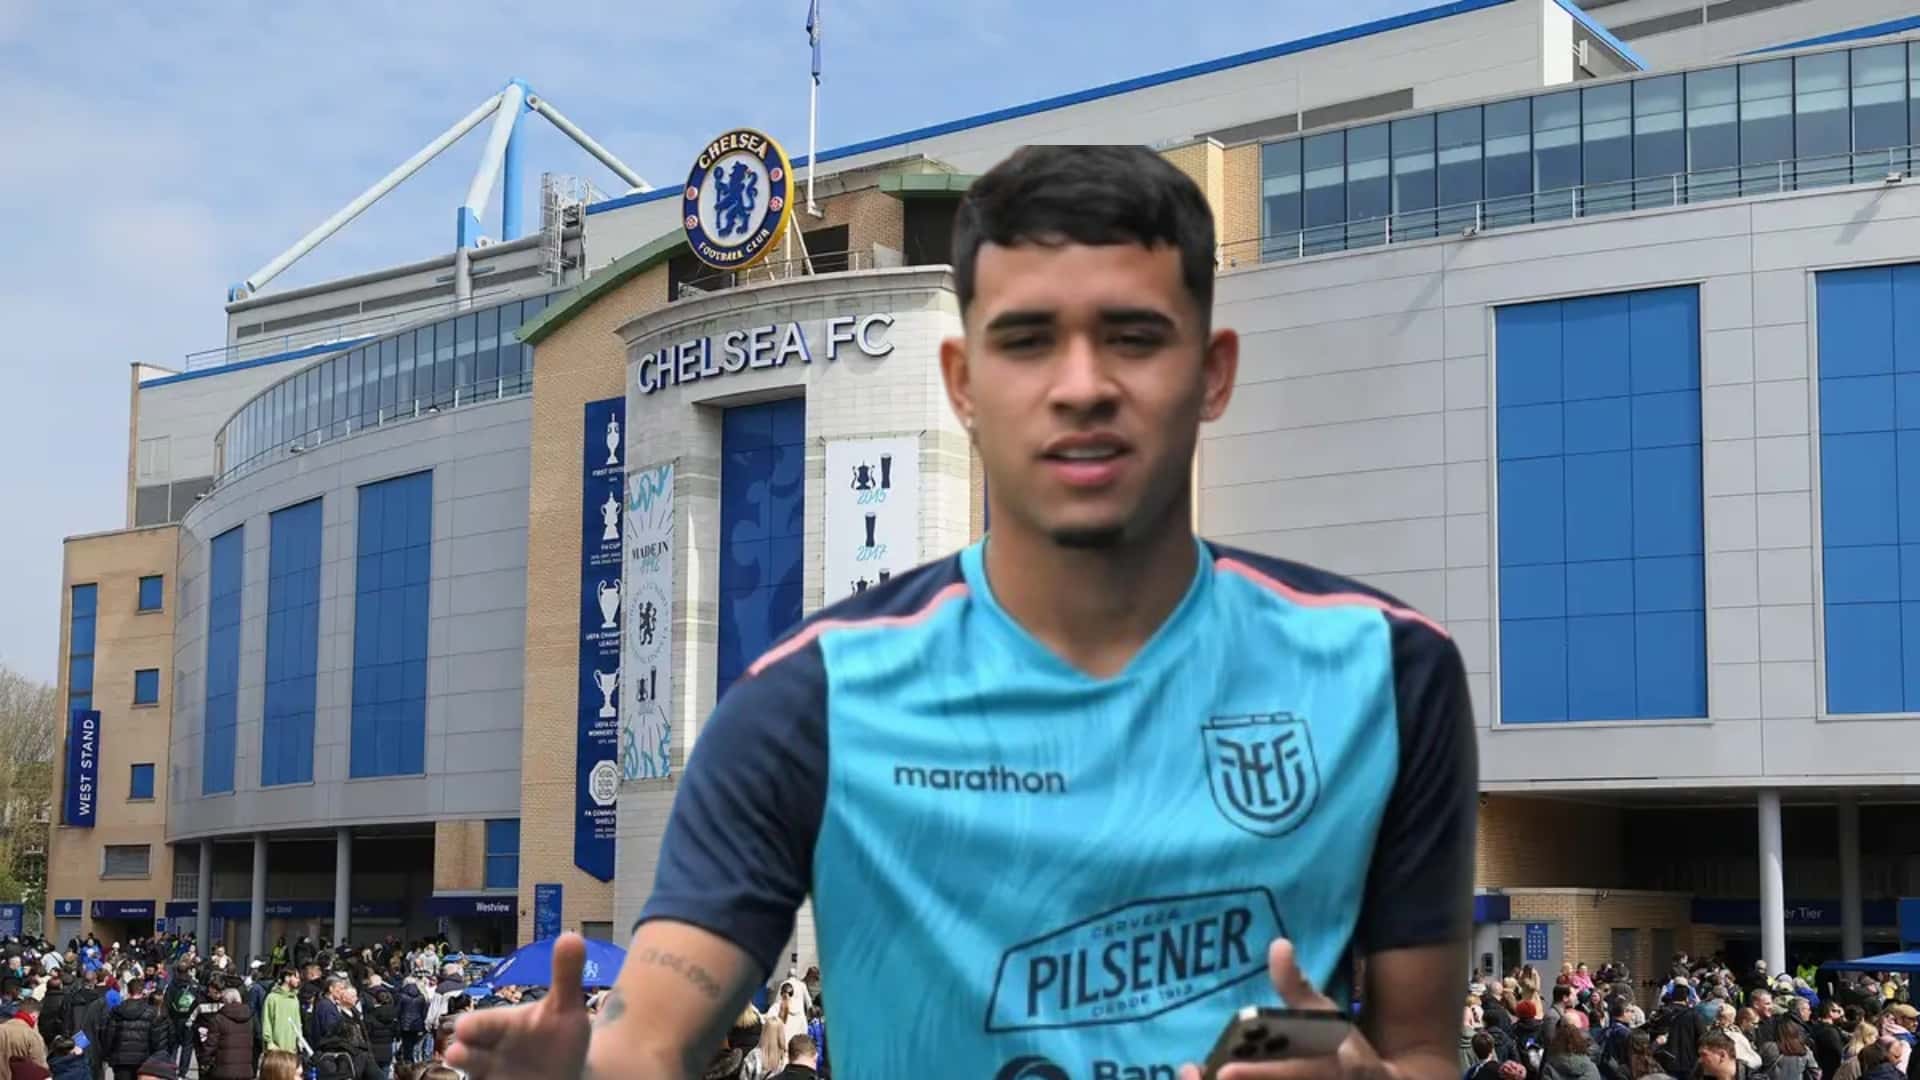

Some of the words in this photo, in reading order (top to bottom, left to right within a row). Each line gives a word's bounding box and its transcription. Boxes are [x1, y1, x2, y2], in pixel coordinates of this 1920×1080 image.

[699, 134, 767, 169] CHELSEA
[699, 241, 744, 262] FOOTBALL
[746, 228, 770, 252] CLUB
[638, 321, 811, 394] CHELSEA
[826, 312, 895, 361] FC
[857, 489, 886, 504] 2015
[856, 544, 887, 562] 2017
[80, 719, 94, 769] STAND
[79, 774, 92, 816] WEST
[894, 764, 1067, 793] marathon
[476, 902, 510, 912] Westview
[1091, 907, 1182, 941] CERVEZA
[1799, 906, 1824, 919] Tier
[1026, 906, 1252, 1018] PILSENER
